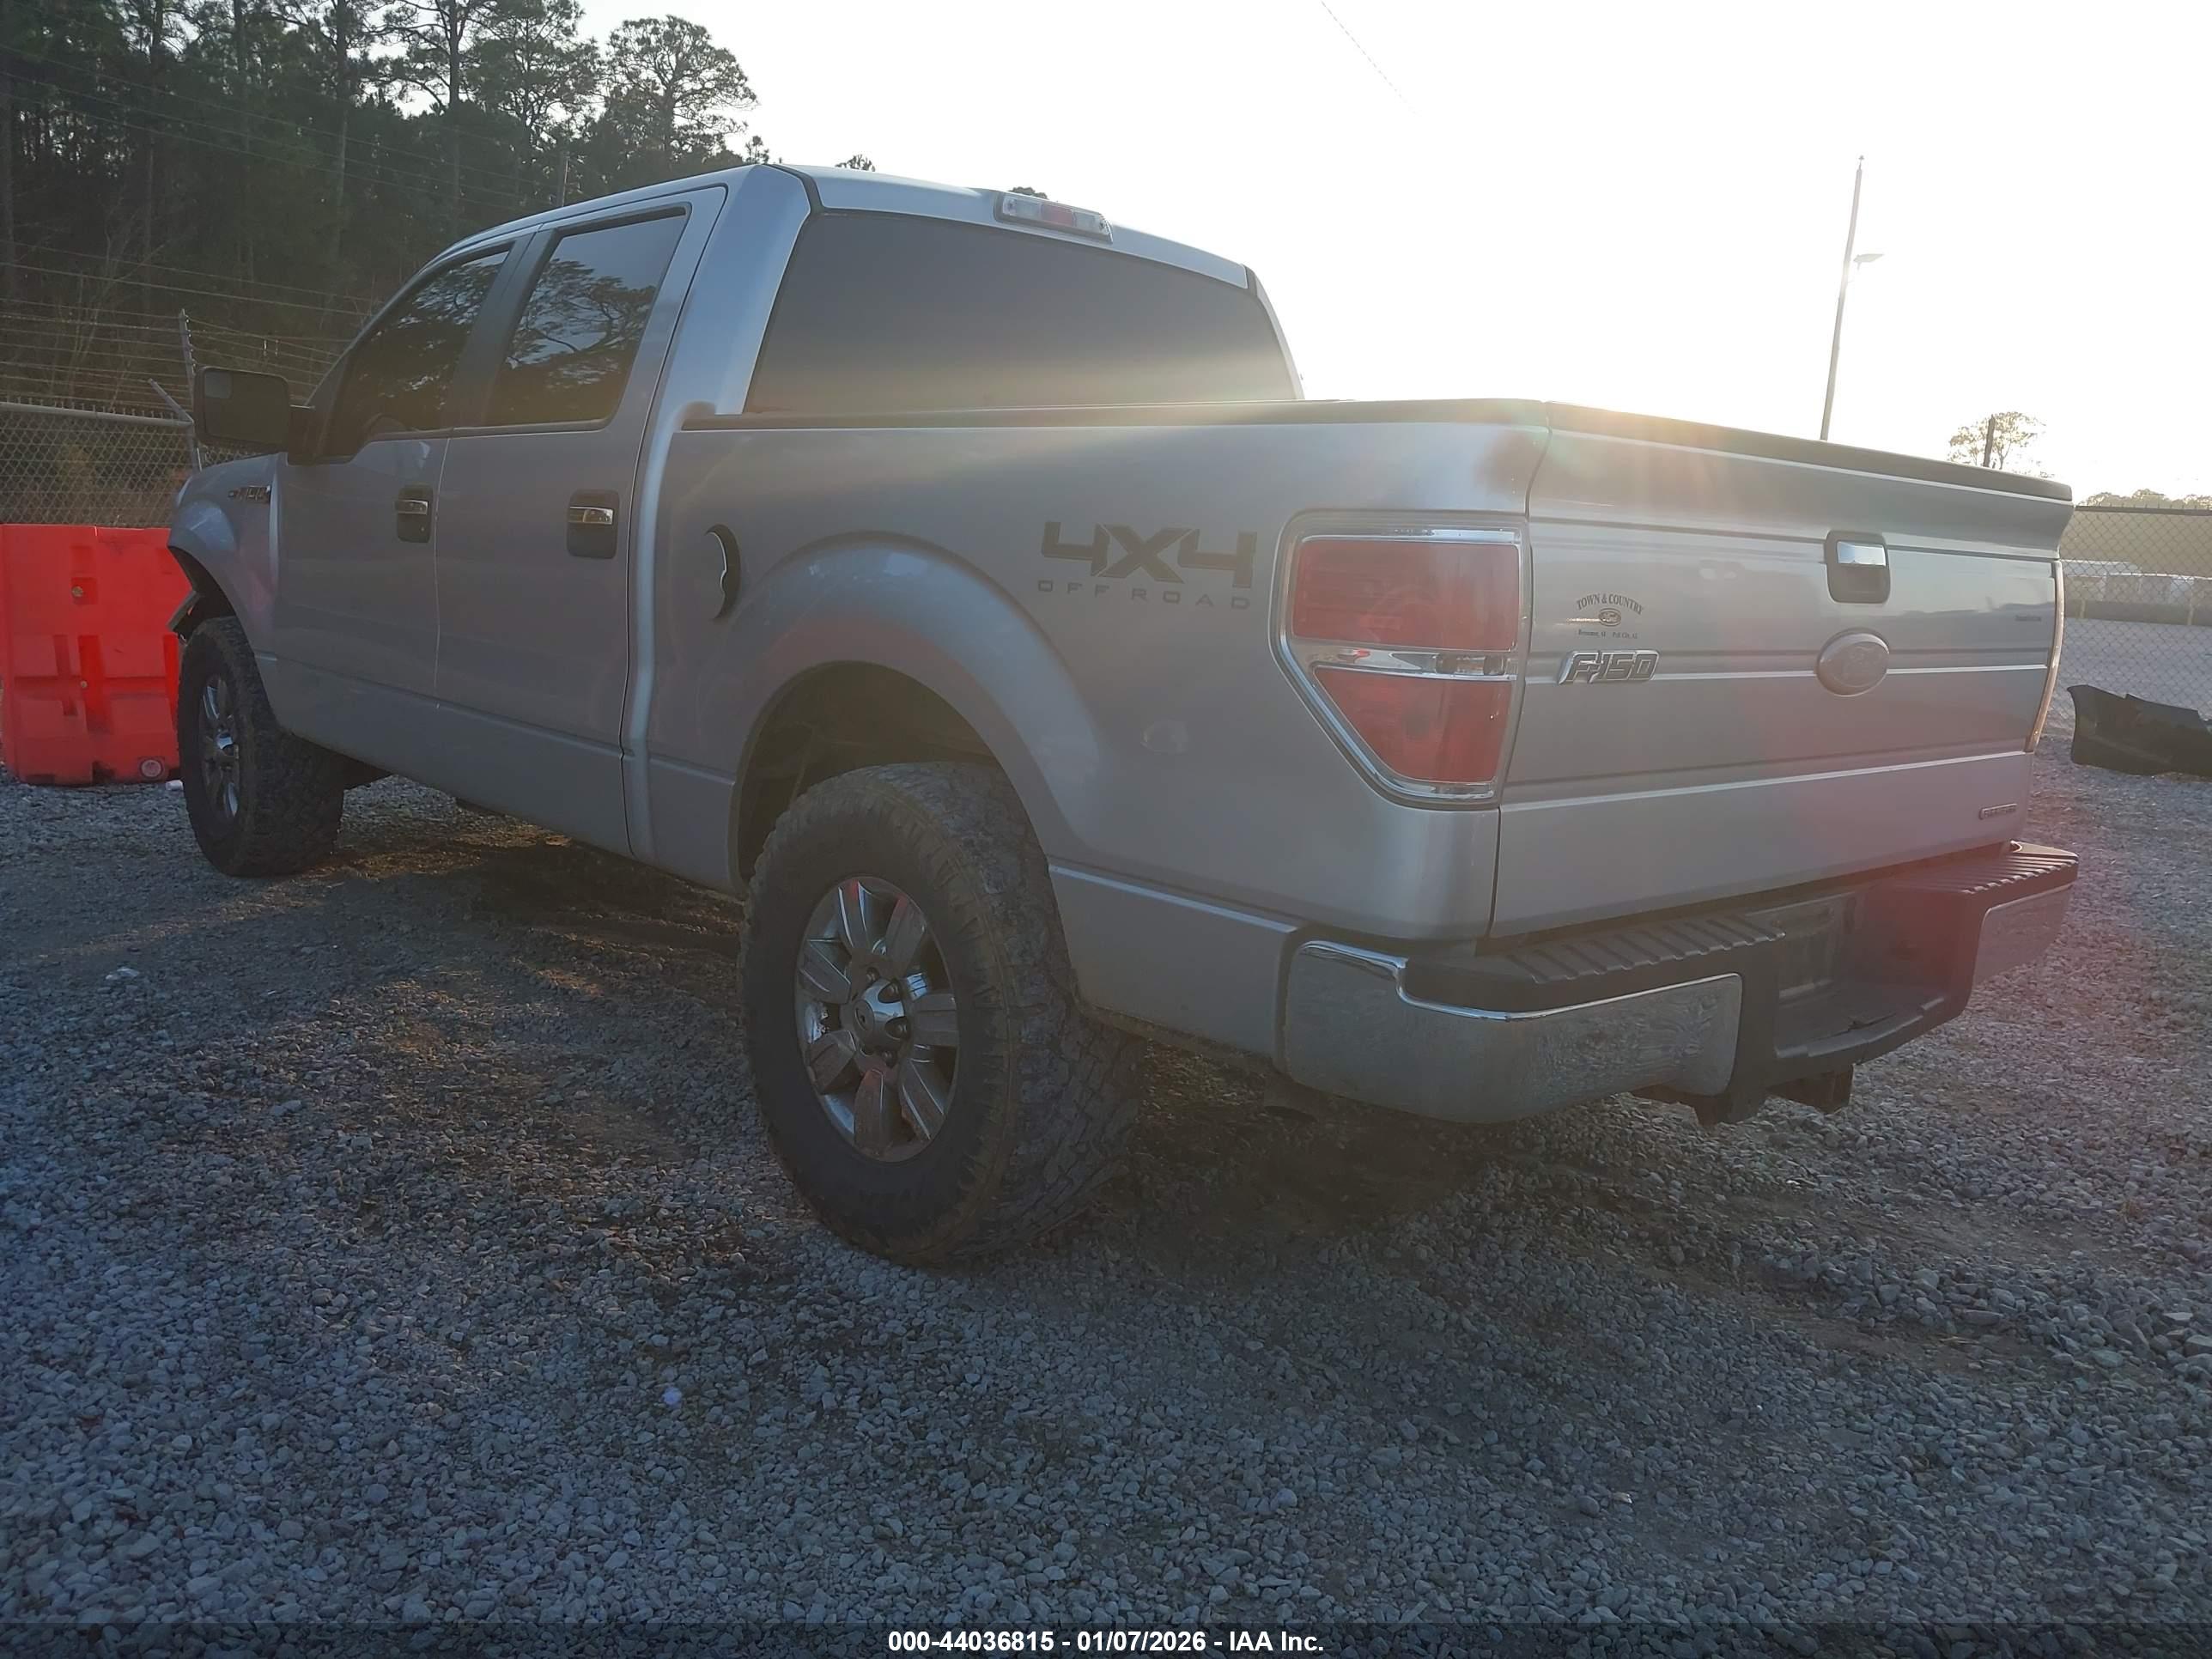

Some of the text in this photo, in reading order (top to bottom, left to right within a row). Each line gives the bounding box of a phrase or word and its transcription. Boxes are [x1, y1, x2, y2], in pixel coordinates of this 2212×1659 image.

[1036, 579, 1251, 611] OFF ROAD
[1577, 592, 1644, 616] TOWN & COUNTRY
